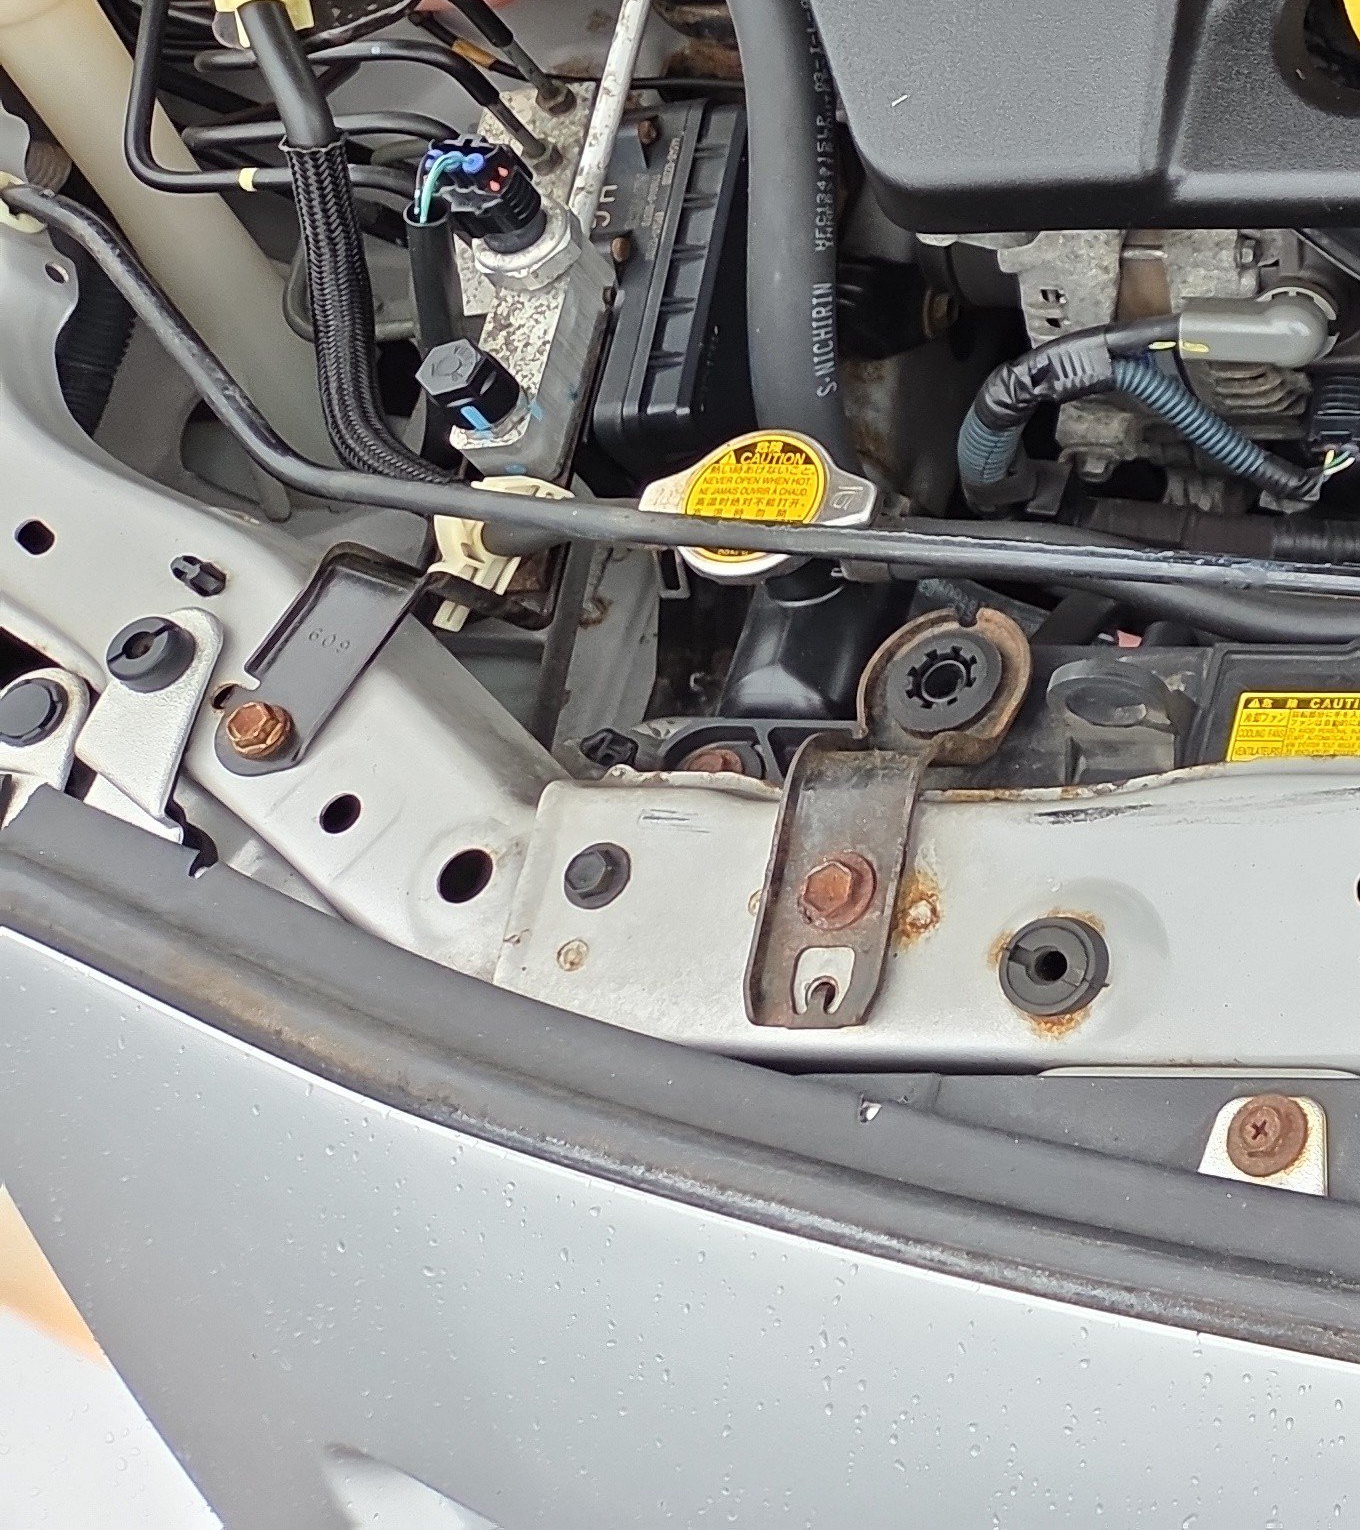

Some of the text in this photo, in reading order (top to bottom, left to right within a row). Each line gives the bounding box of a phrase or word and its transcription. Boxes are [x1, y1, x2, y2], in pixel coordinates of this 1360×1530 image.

[740, 453, 805, 464] CAUTION
[703, 477, 813, 486] NEVER OPEN WHEN HOT.
[699, 487, 709, 495] NE
[711, 487, 738, 495] JAMAIS
